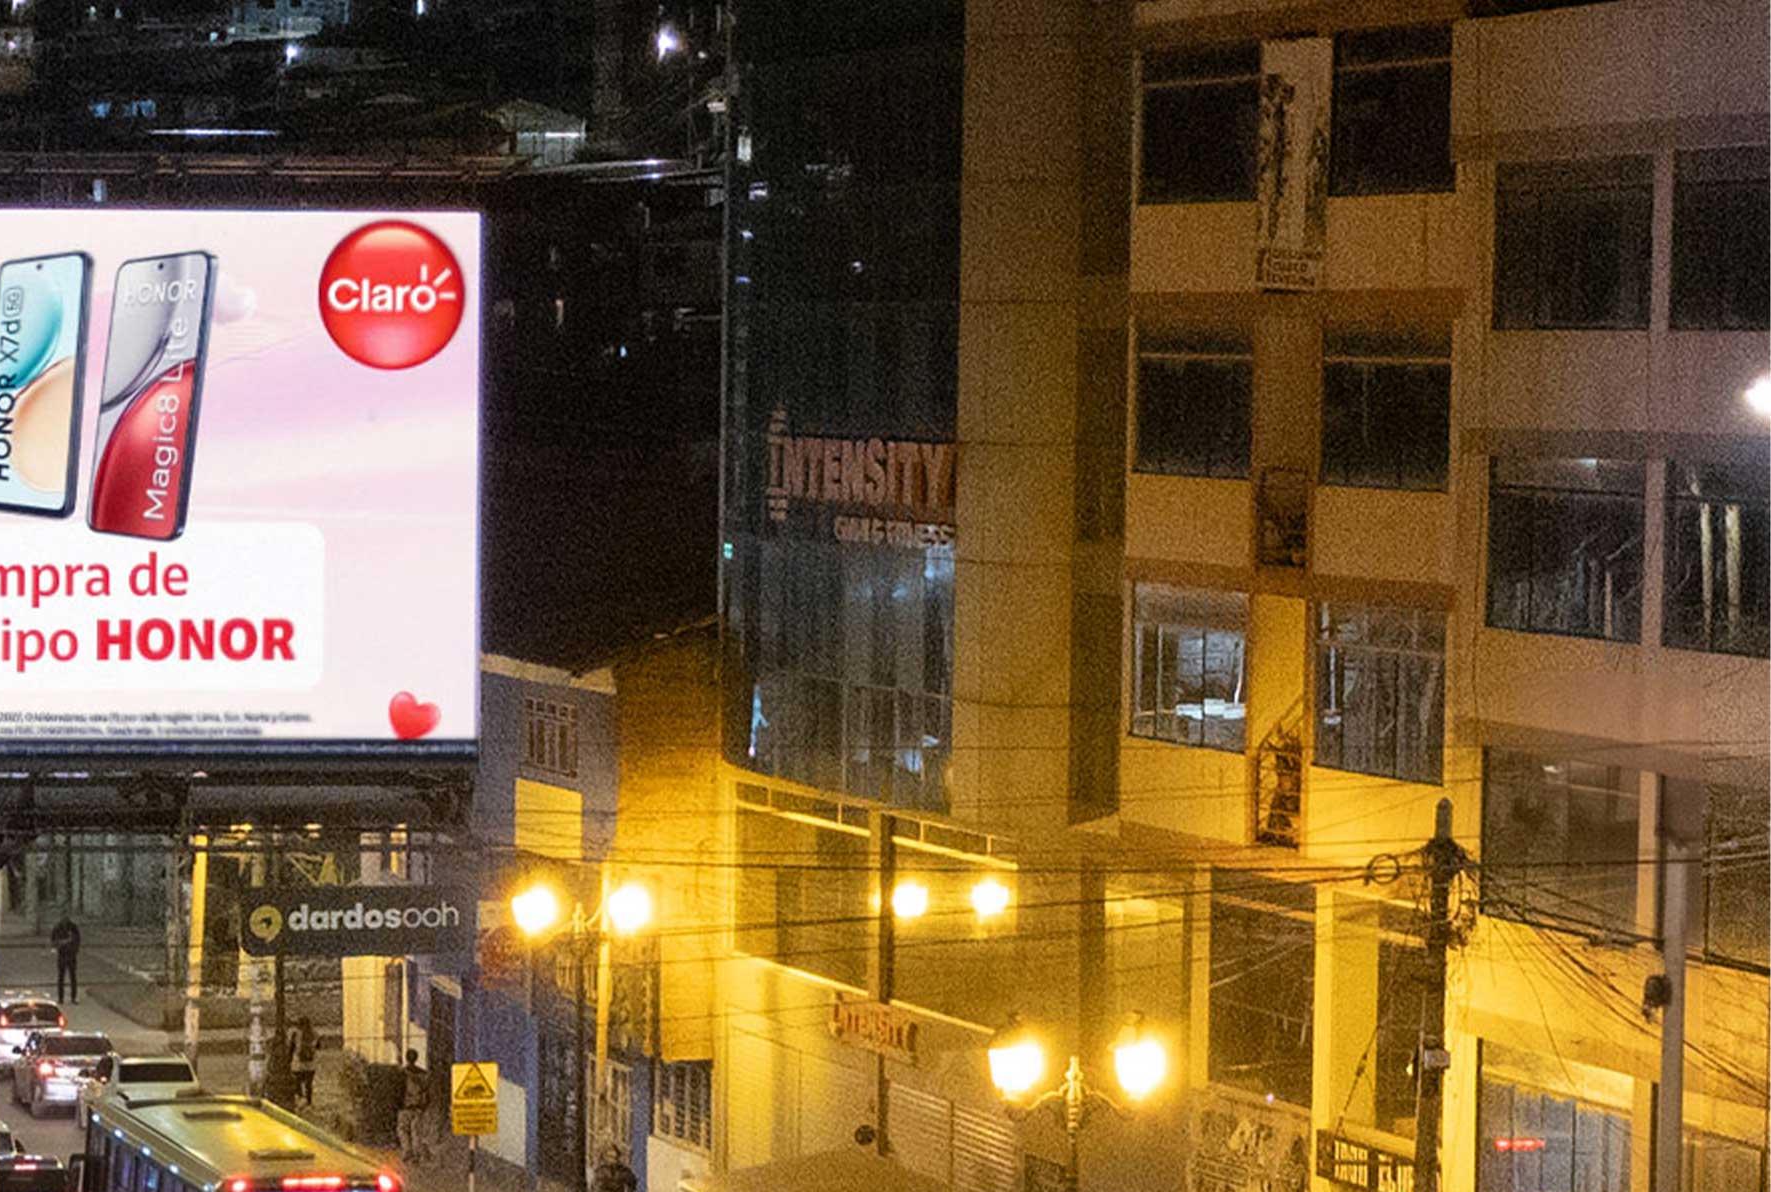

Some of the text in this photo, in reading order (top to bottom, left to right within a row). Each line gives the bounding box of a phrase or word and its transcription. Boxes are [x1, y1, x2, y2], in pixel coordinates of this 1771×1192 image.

[328, 277, 436, 312] Claro
[143, 394, 180, 521] Magic8
[766, 435, 953, 510] INTENSITY
[128, 551, 190, 598] de
[96, 617, 297, 662] HONOR
[288, 901, 460, 931] dardosooh
